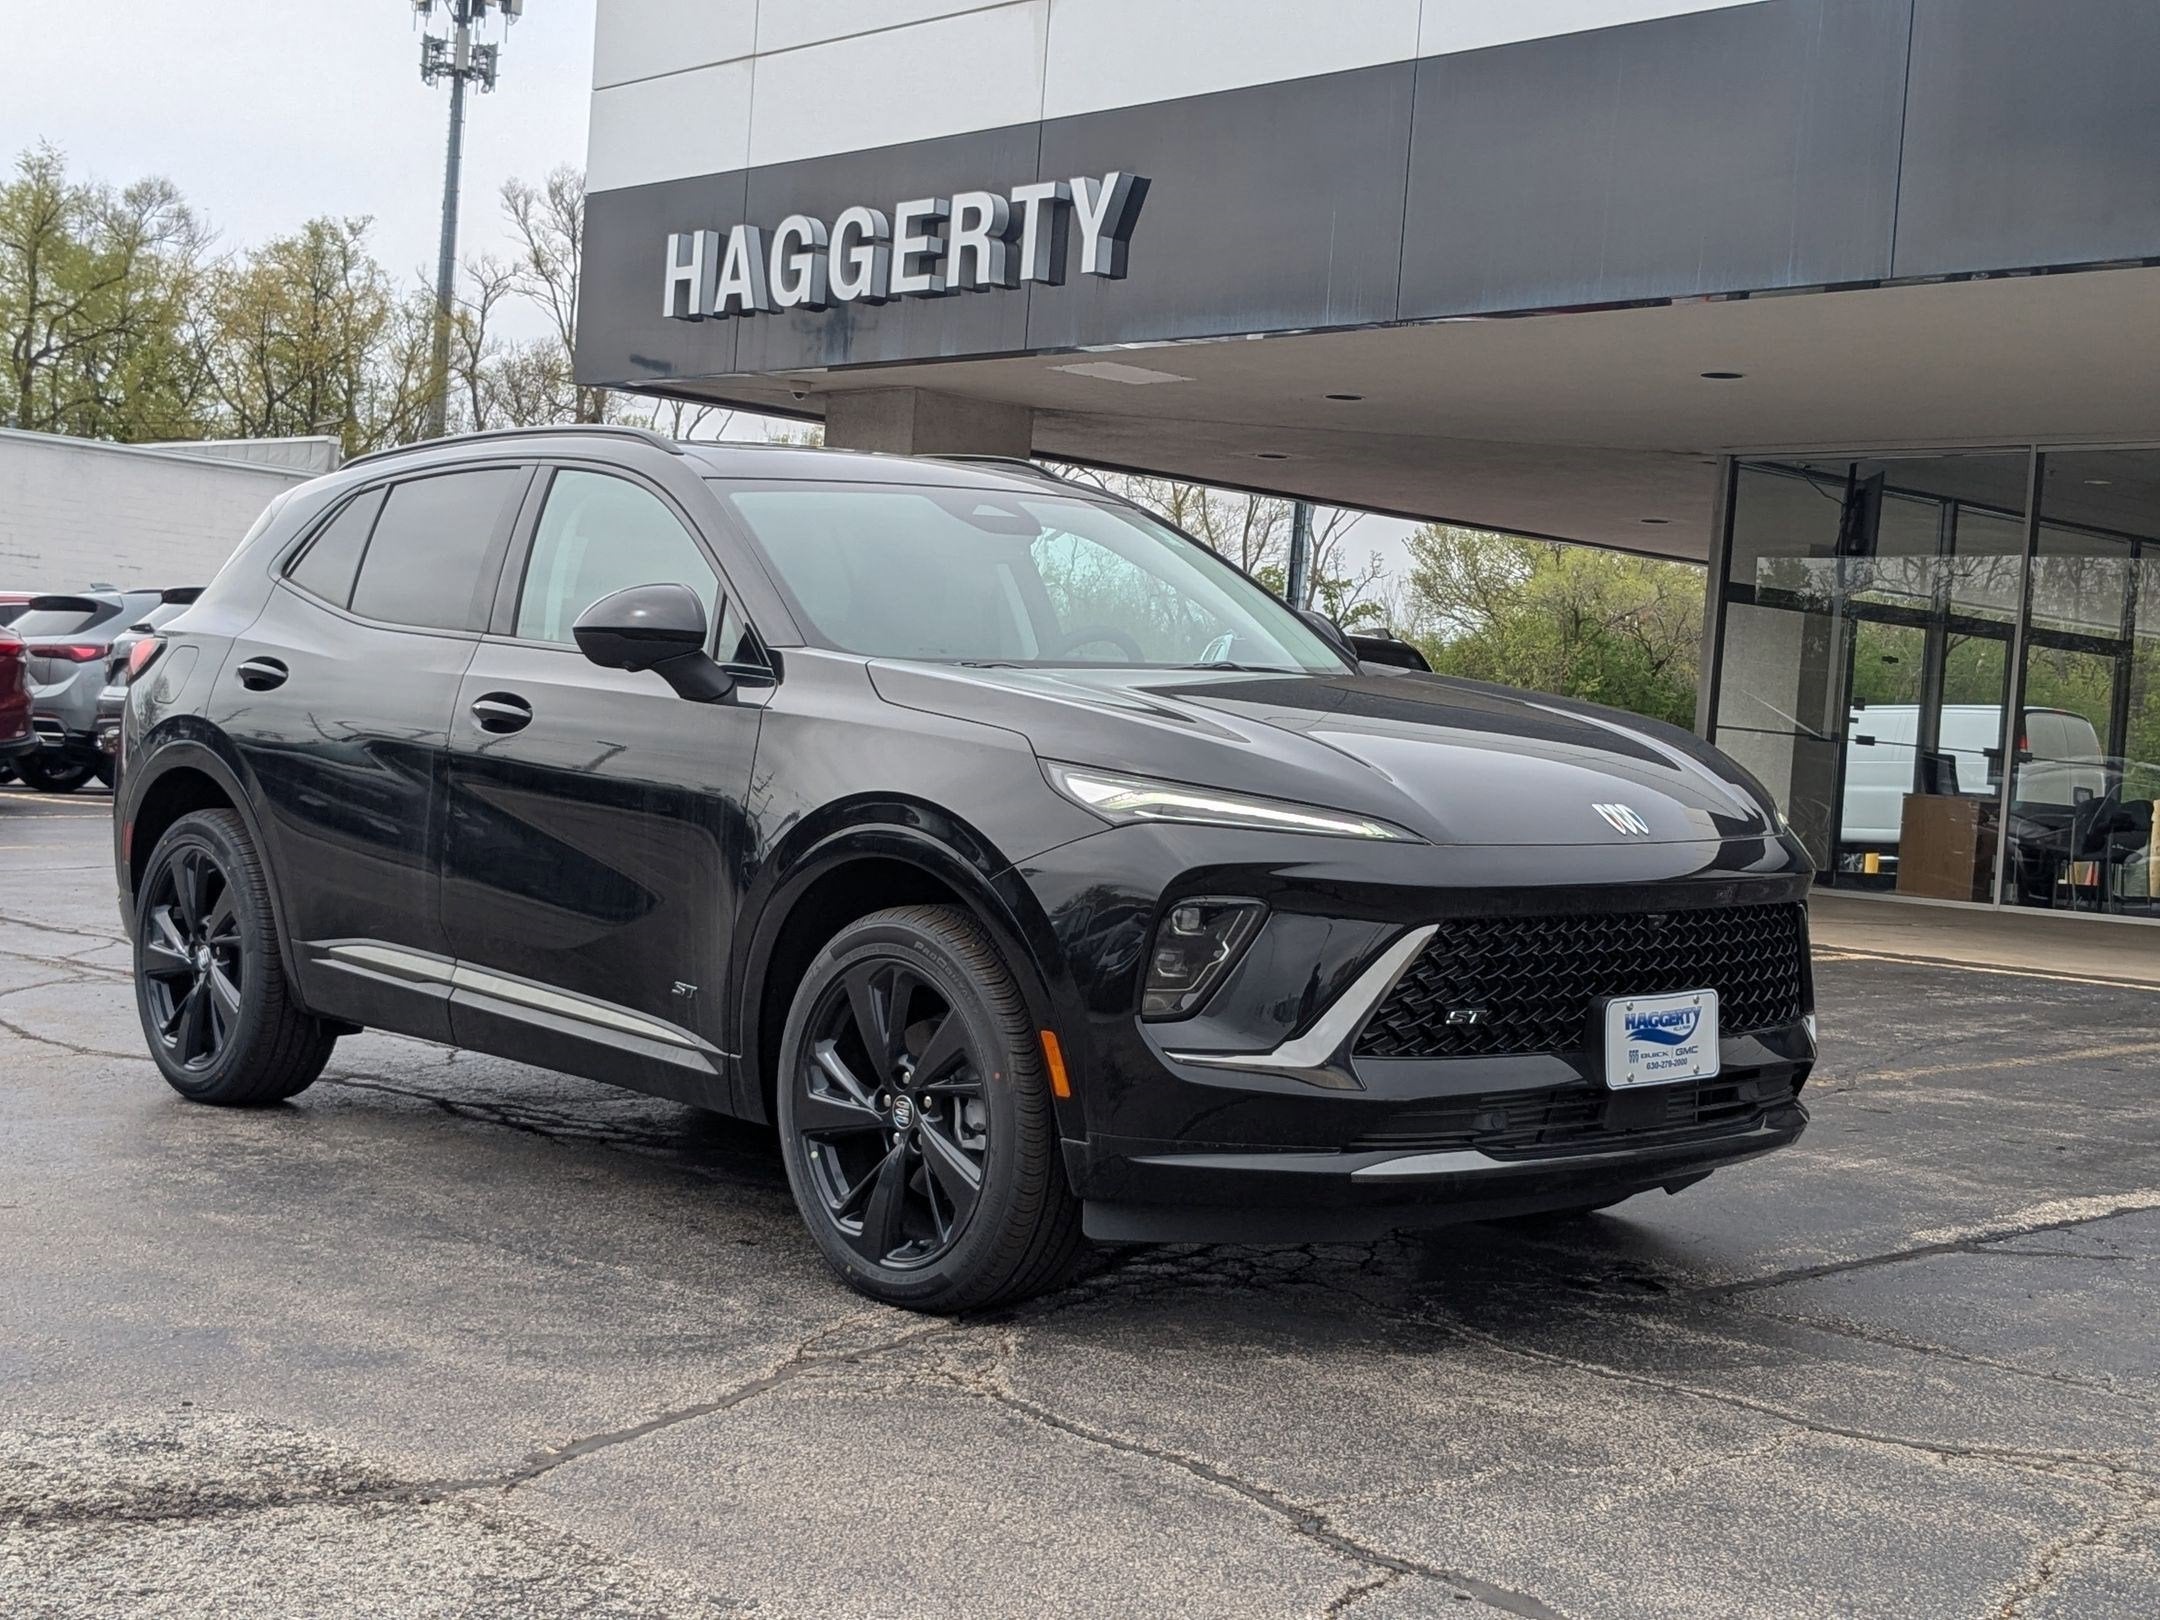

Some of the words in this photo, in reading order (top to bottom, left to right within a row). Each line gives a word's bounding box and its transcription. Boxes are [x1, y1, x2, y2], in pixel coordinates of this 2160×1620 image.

[662, 171, 1151, 322] HAGGERTY
[672, 981, 698, 999] ST
[1445, 1009, 1487, 1024] ST
[1624, 1006, 1702, 1031] HAGGERTY
[1640, 1051, 1669, 1059] BUICK
[1675, 1045, 1699, 1056] GMC
